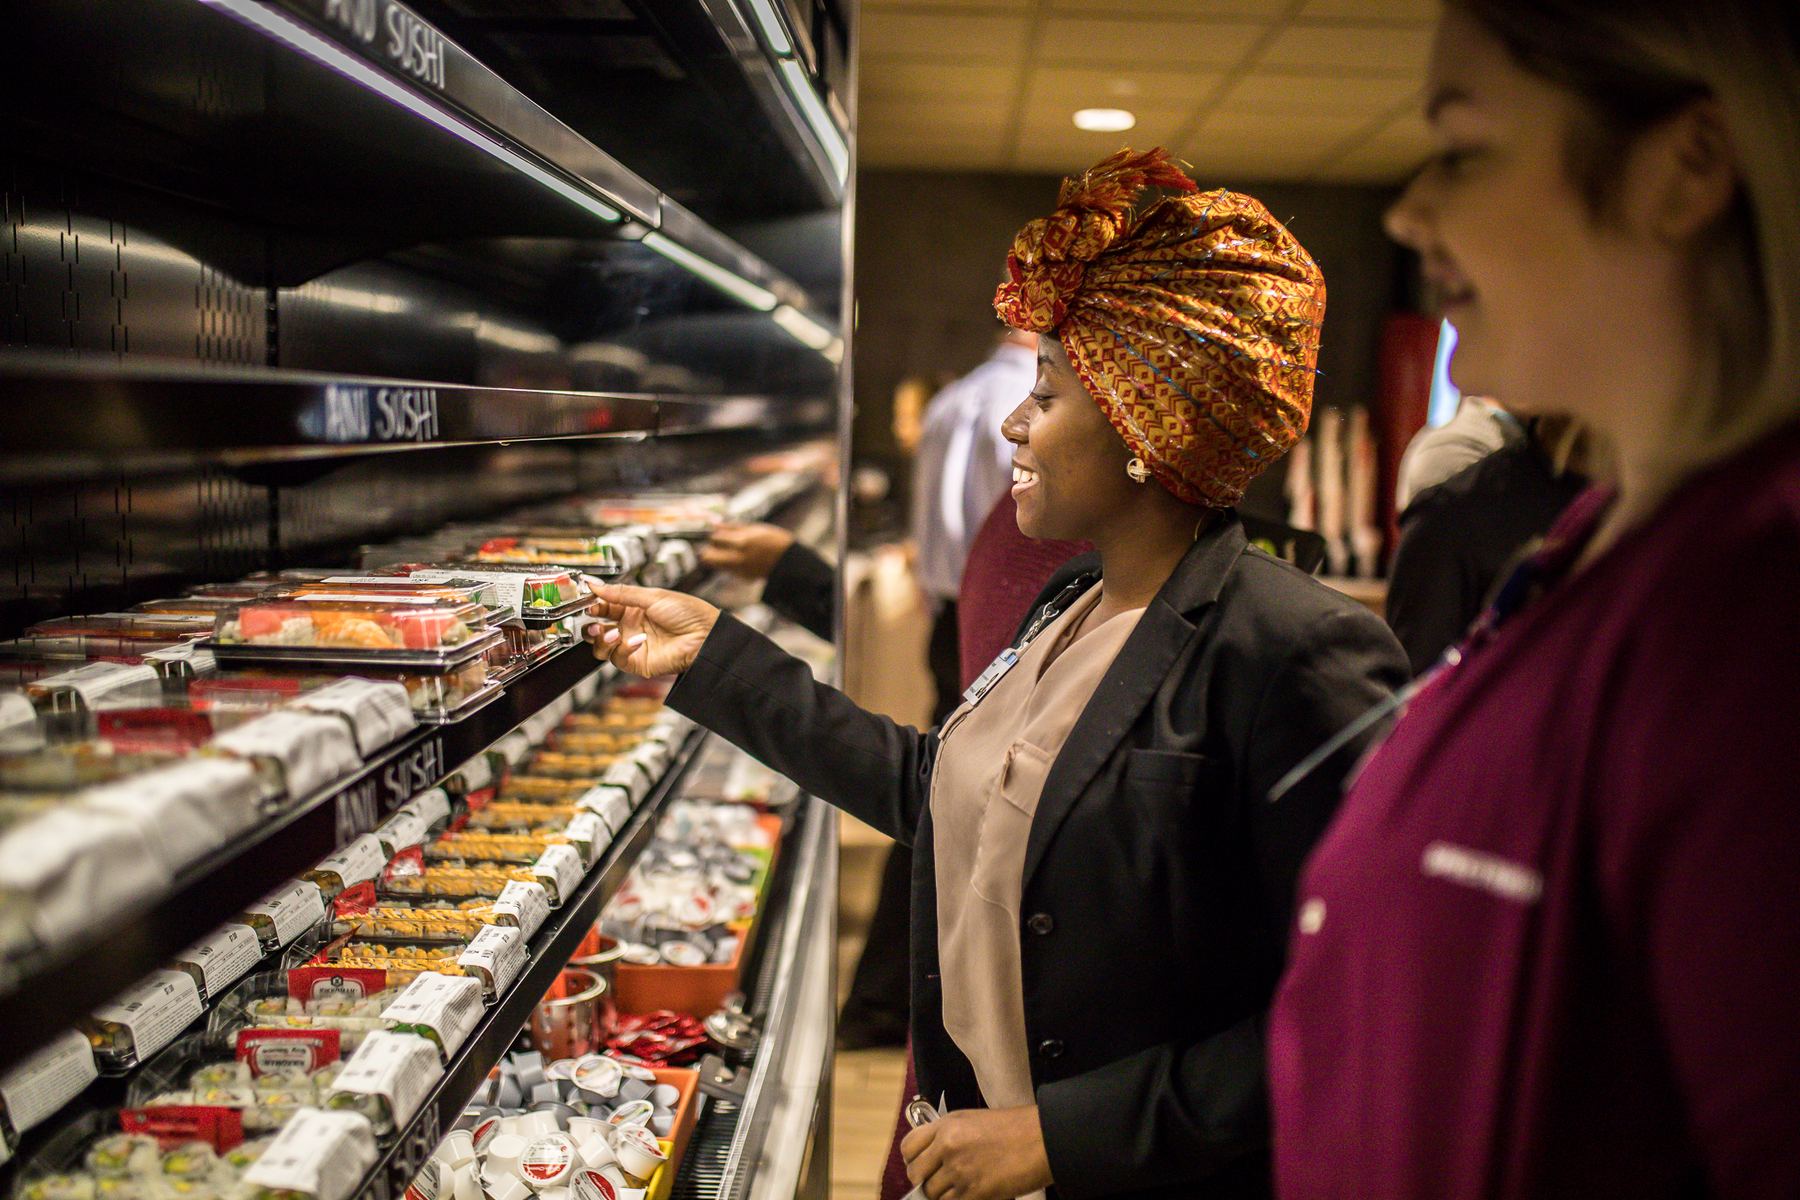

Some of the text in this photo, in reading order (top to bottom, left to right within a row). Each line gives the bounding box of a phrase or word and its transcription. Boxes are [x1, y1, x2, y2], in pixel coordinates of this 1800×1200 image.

[386, 3, 445, 90] SUSHI
[375, 388, 439, 442] SUSHI
[384, 737, 444, 810] SUSHI
